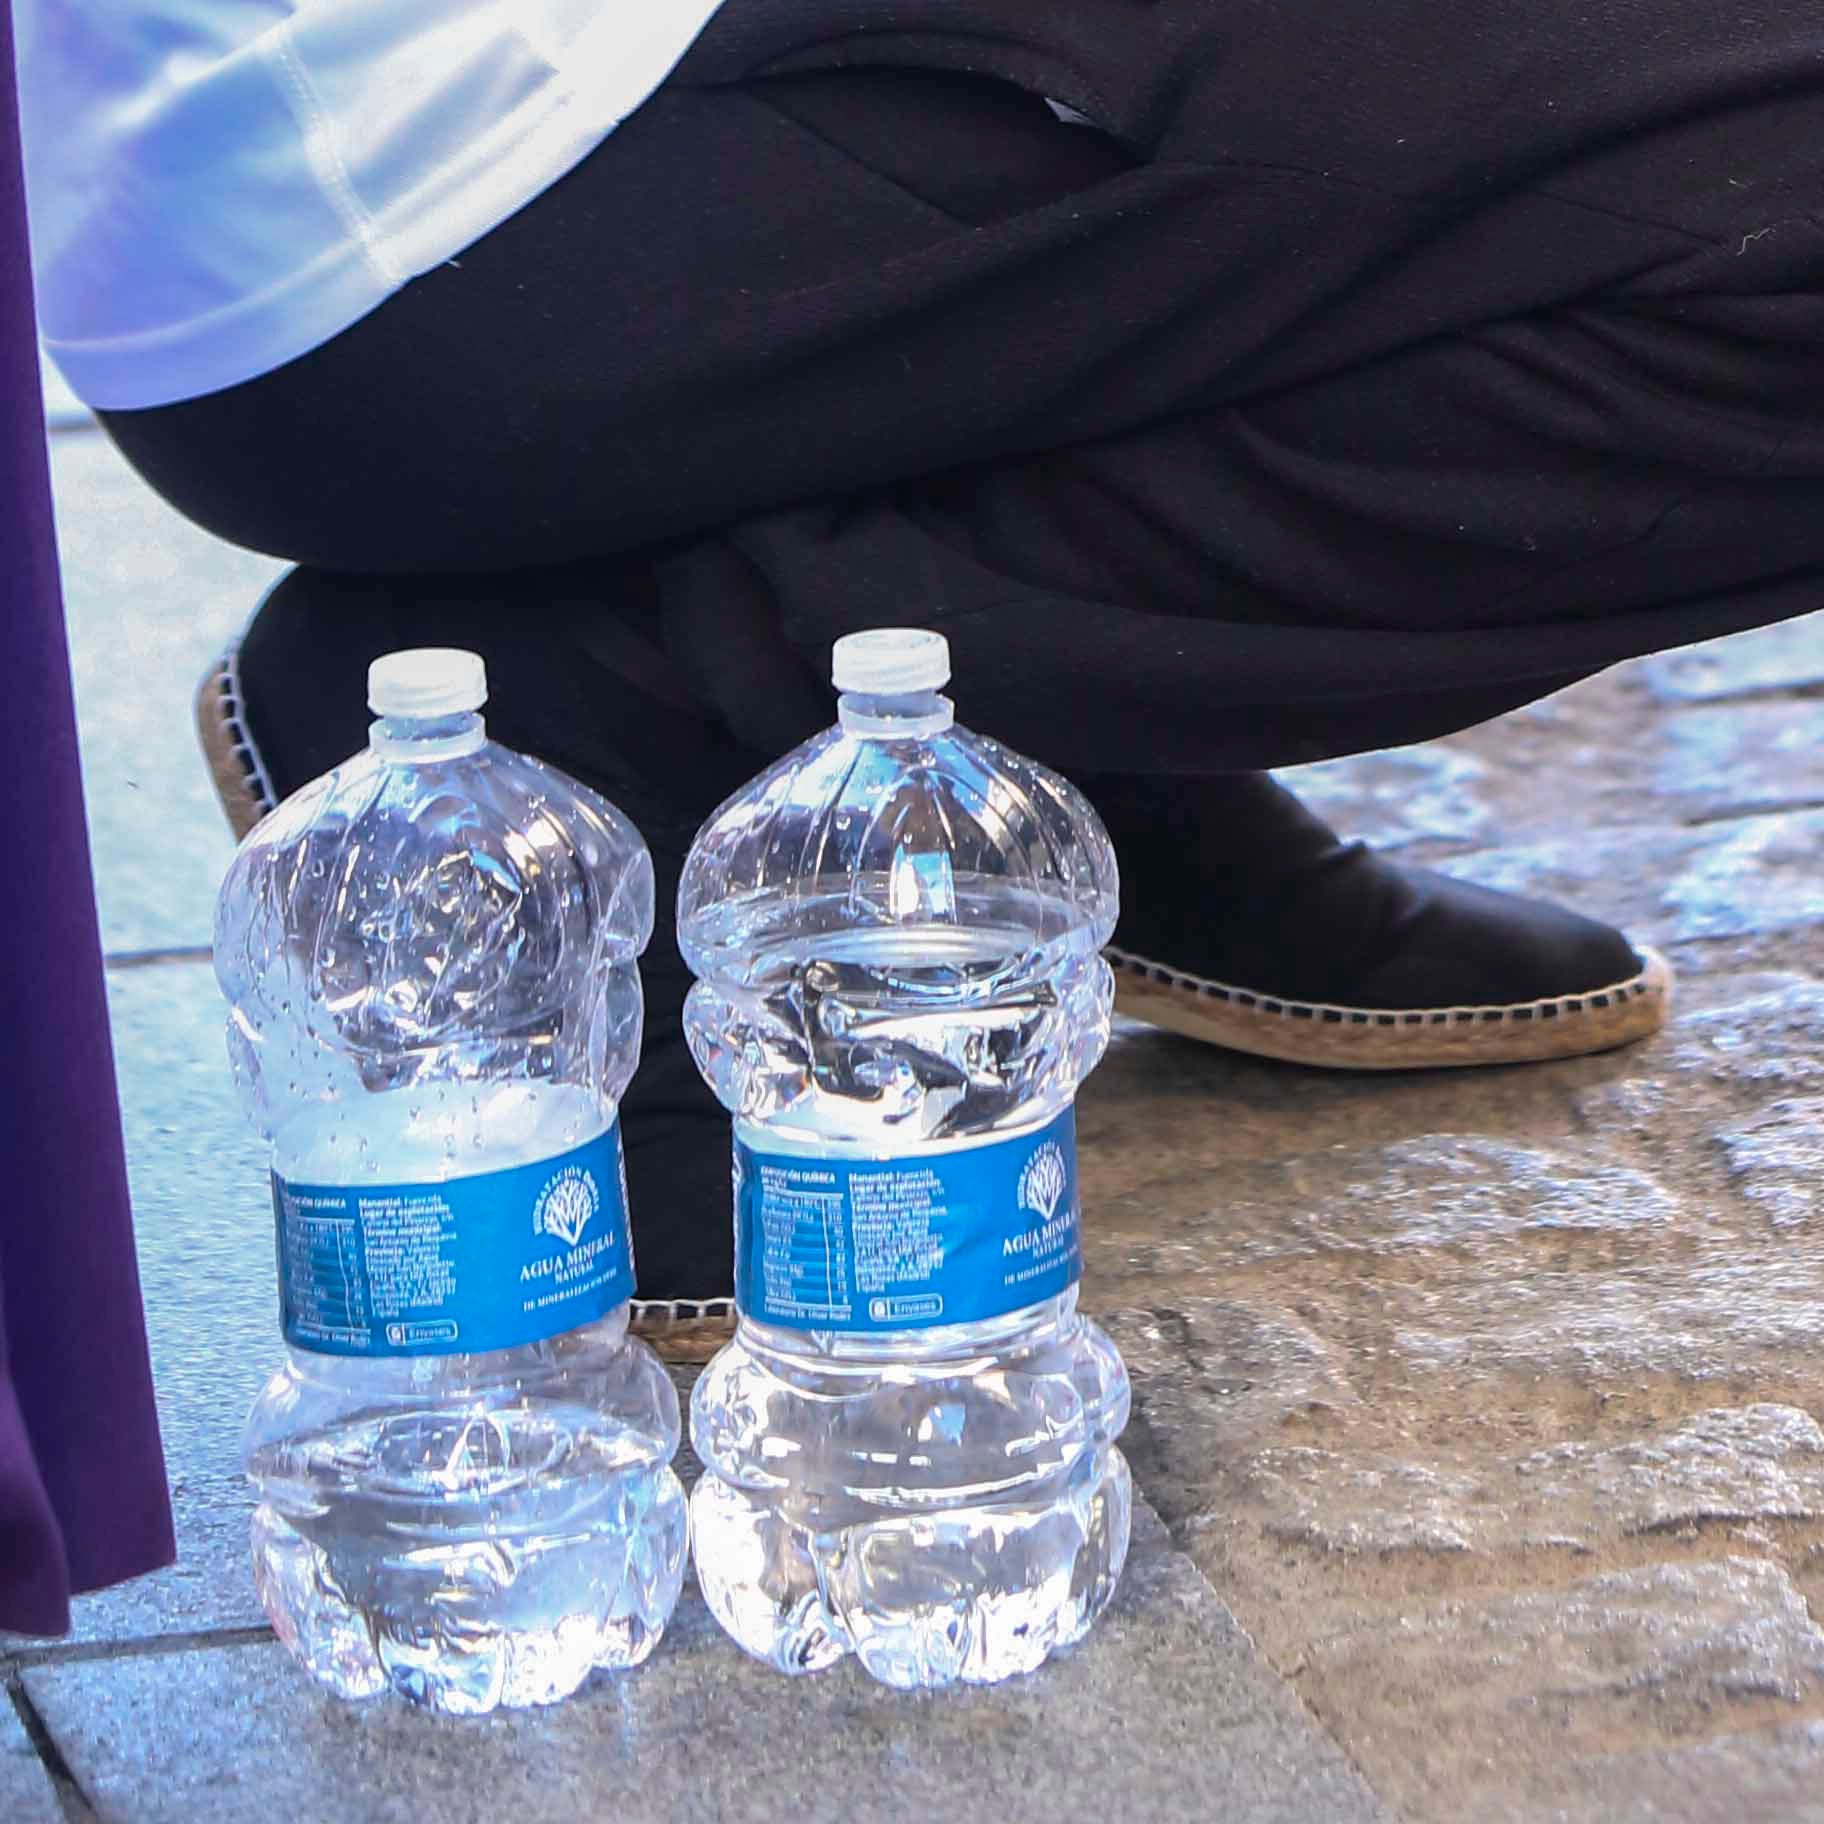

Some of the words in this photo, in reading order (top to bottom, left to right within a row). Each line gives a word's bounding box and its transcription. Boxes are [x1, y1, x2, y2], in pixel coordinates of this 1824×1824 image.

[520, 1255, 563, 1282] AGUA
[566, 1231, 616, 1266] MINERAL
[1002, 1228, 1040, 1257] AGUA
